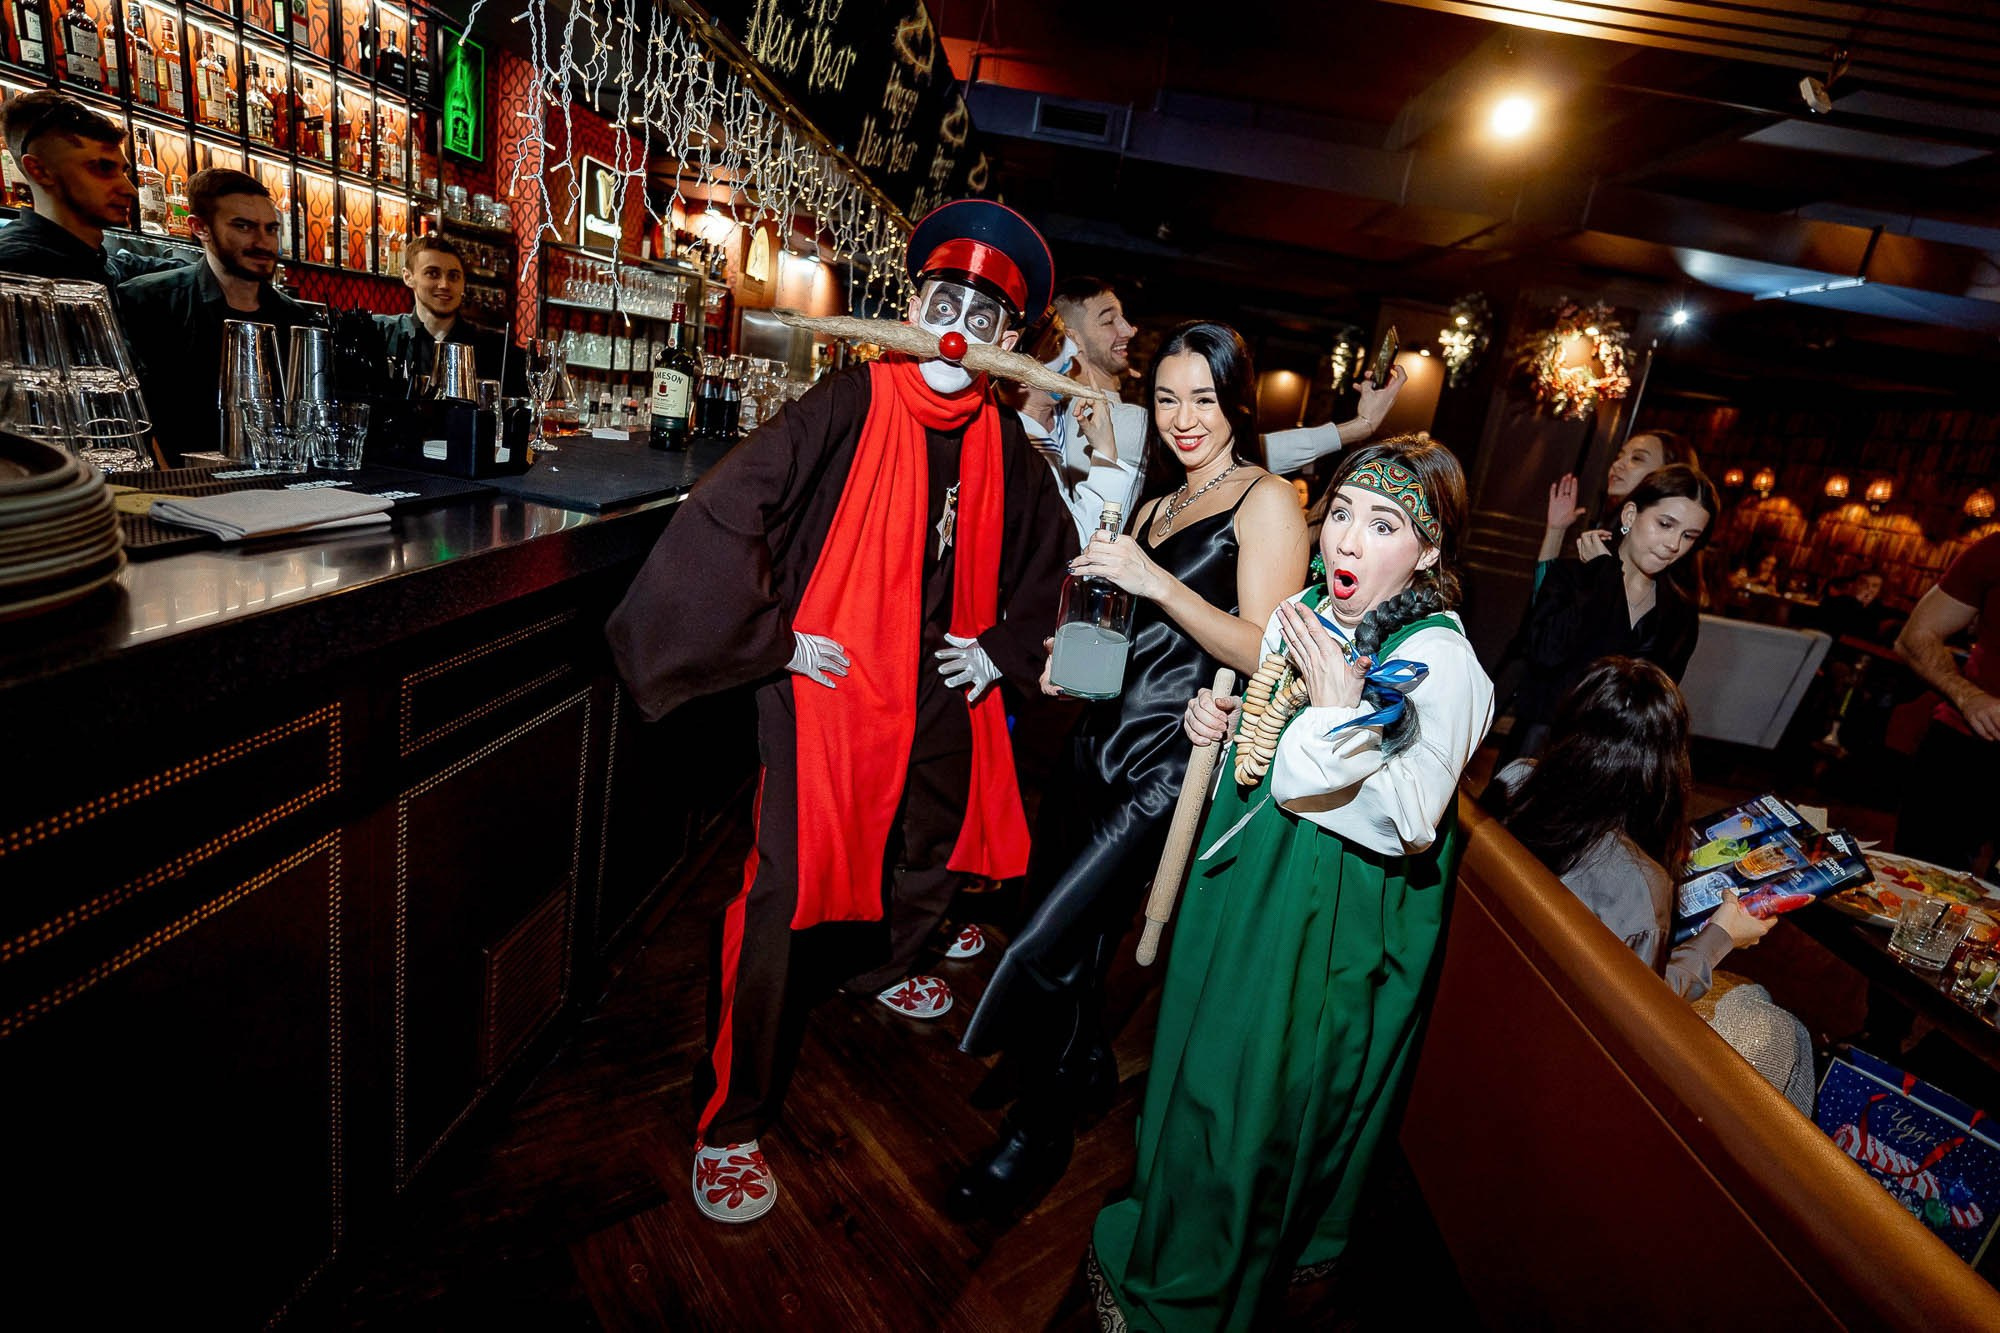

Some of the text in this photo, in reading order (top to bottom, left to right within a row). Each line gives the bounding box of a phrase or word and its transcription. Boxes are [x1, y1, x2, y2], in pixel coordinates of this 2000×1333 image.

[808, 26, 857, 91] Year
[855, 113, 891, 168] New
[654, 371, 684, 385] MESON
